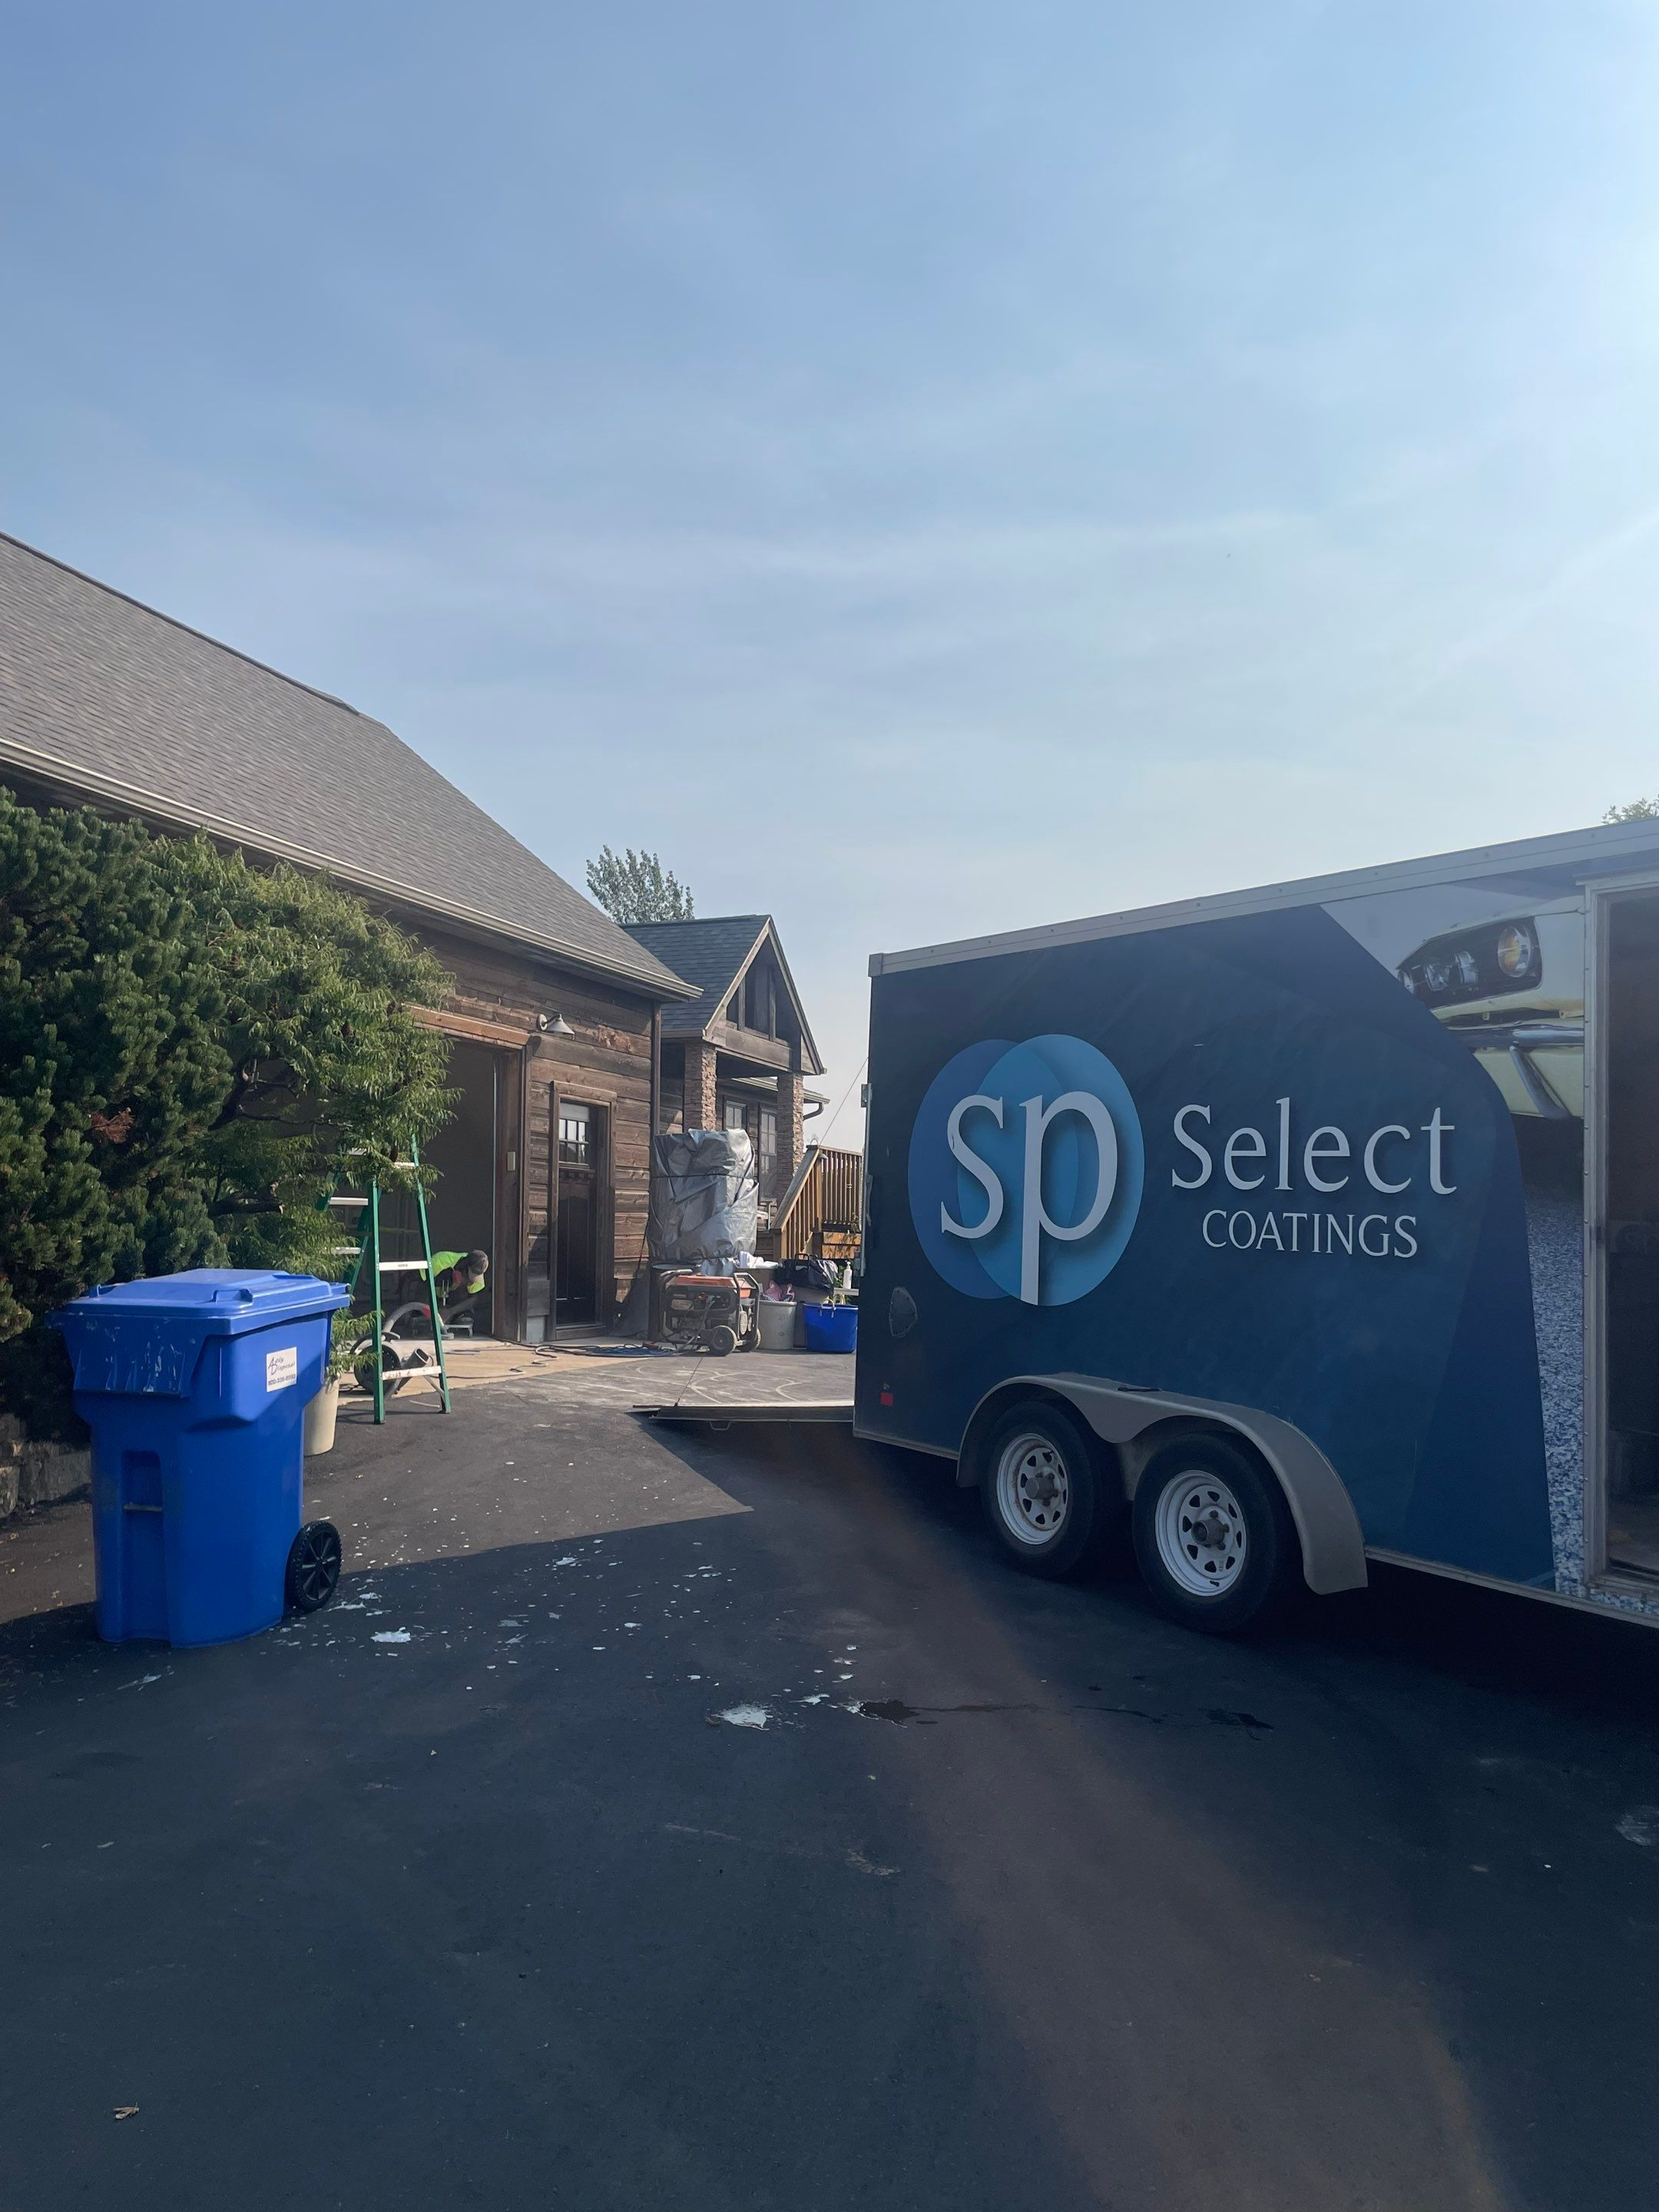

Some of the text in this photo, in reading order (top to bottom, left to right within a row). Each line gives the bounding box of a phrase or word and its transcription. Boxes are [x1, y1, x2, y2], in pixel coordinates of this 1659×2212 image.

[1171, 1097, 1457, 1195] Select
[941, 1091, 1118, 1306] sp
[1202, 1210, 1419, 1259] COATINGS
